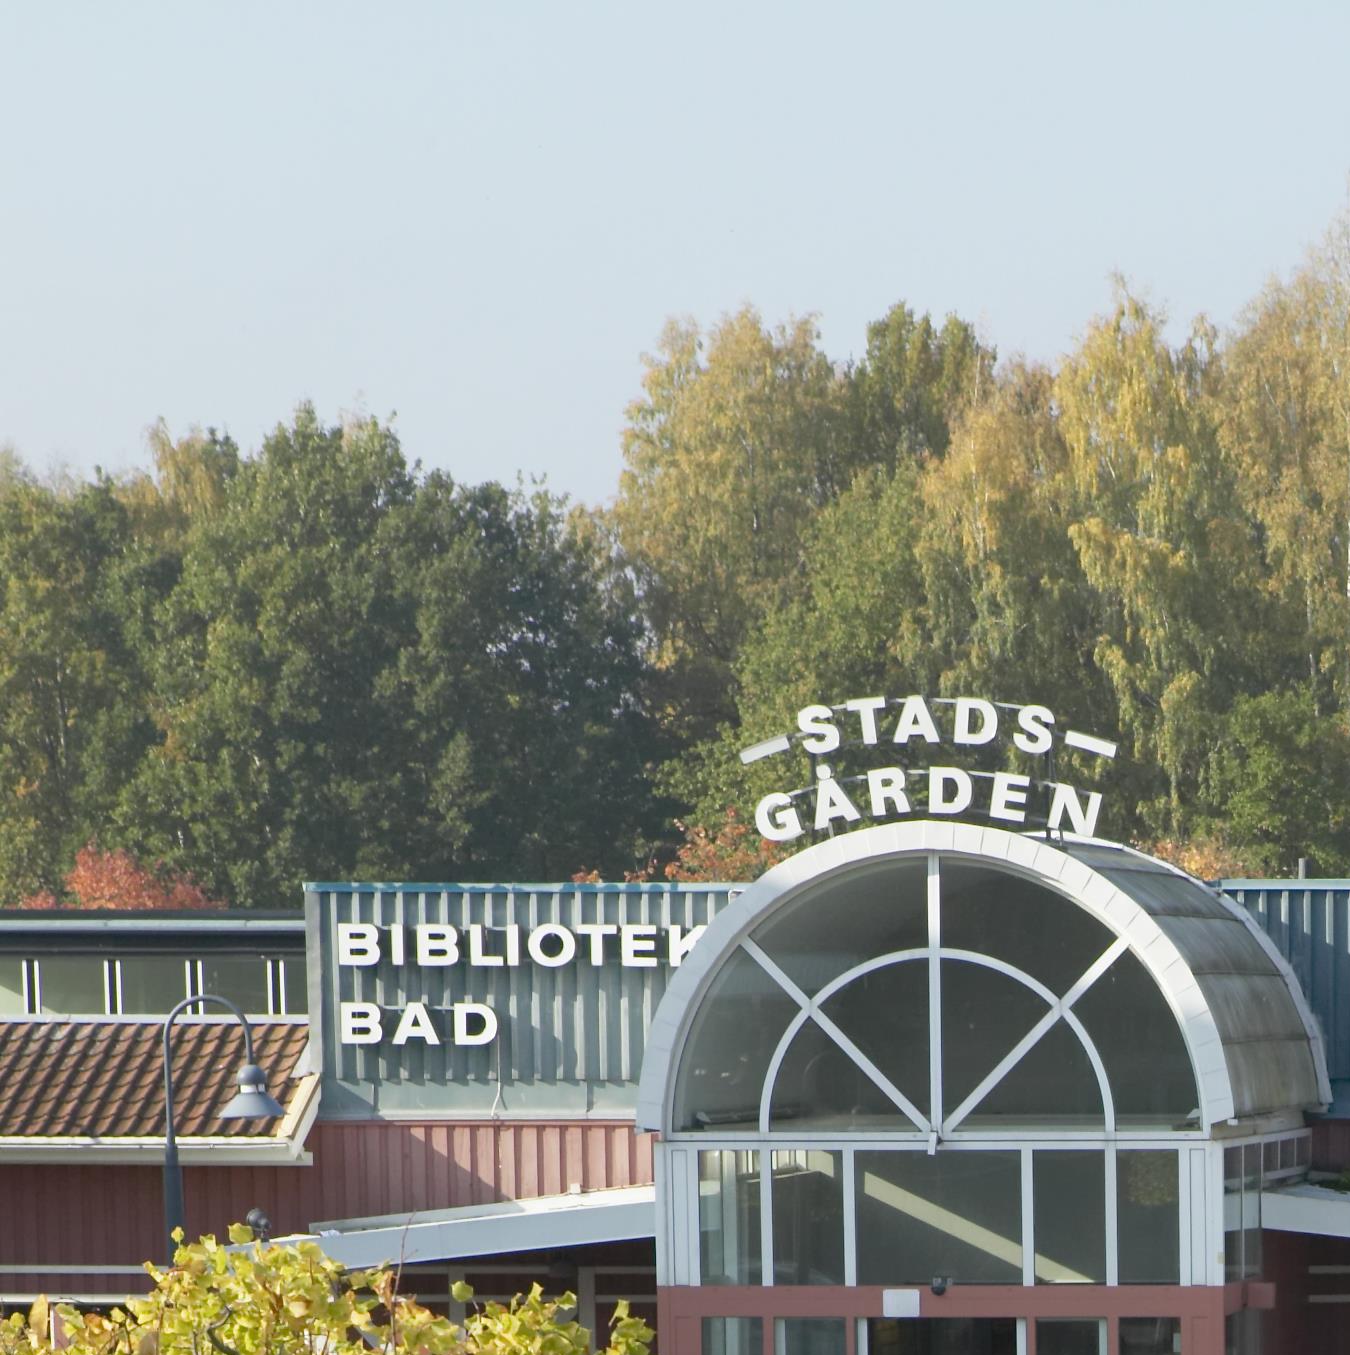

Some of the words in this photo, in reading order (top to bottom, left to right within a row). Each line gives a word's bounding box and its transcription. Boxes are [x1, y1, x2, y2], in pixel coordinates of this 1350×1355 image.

[755, 764, 1102, 842] GÅRDEN
[338, 923, 708, 967] BIBLIOTEK
[341, 1002, 498, 1045] BAD
